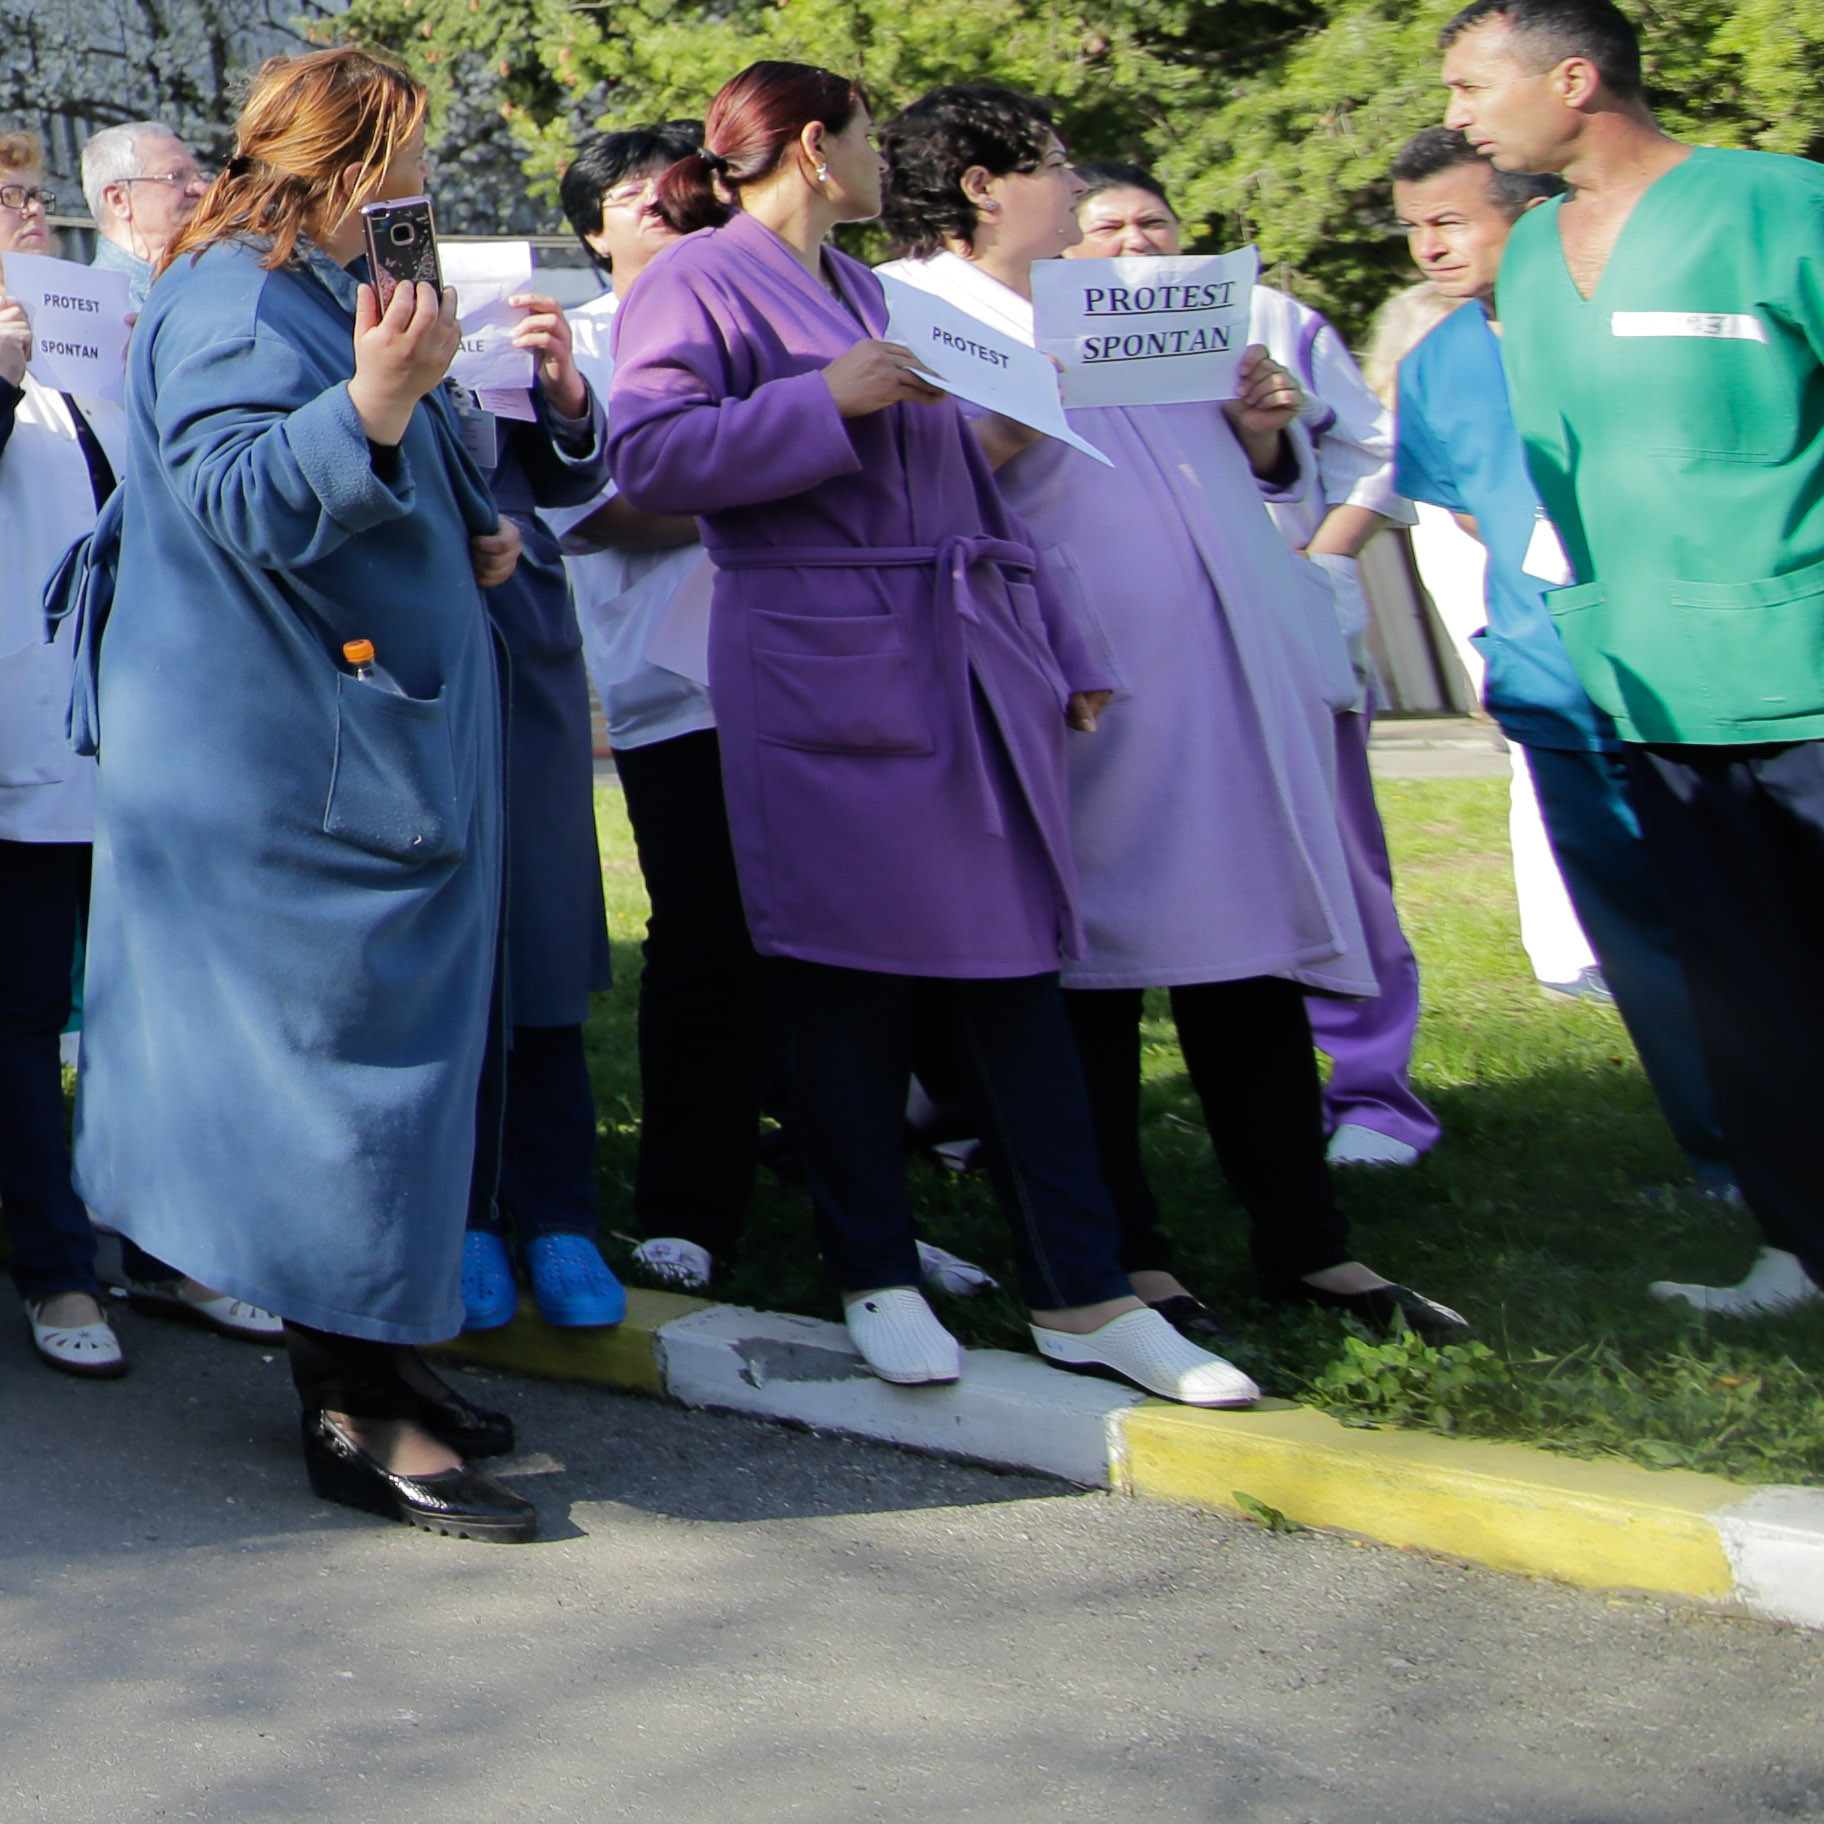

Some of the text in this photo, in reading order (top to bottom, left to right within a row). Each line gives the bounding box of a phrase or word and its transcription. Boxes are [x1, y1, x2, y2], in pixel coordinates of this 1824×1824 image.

[44, 293, 100, 313] PROTEST
[1084, 281, 1235, 312] PROTEST
[41, 340, 98, 359] SPONTAN
[933, 326, 1009, 368] PROTEST
[1083, 325, 1231, 360] SPONTAN
